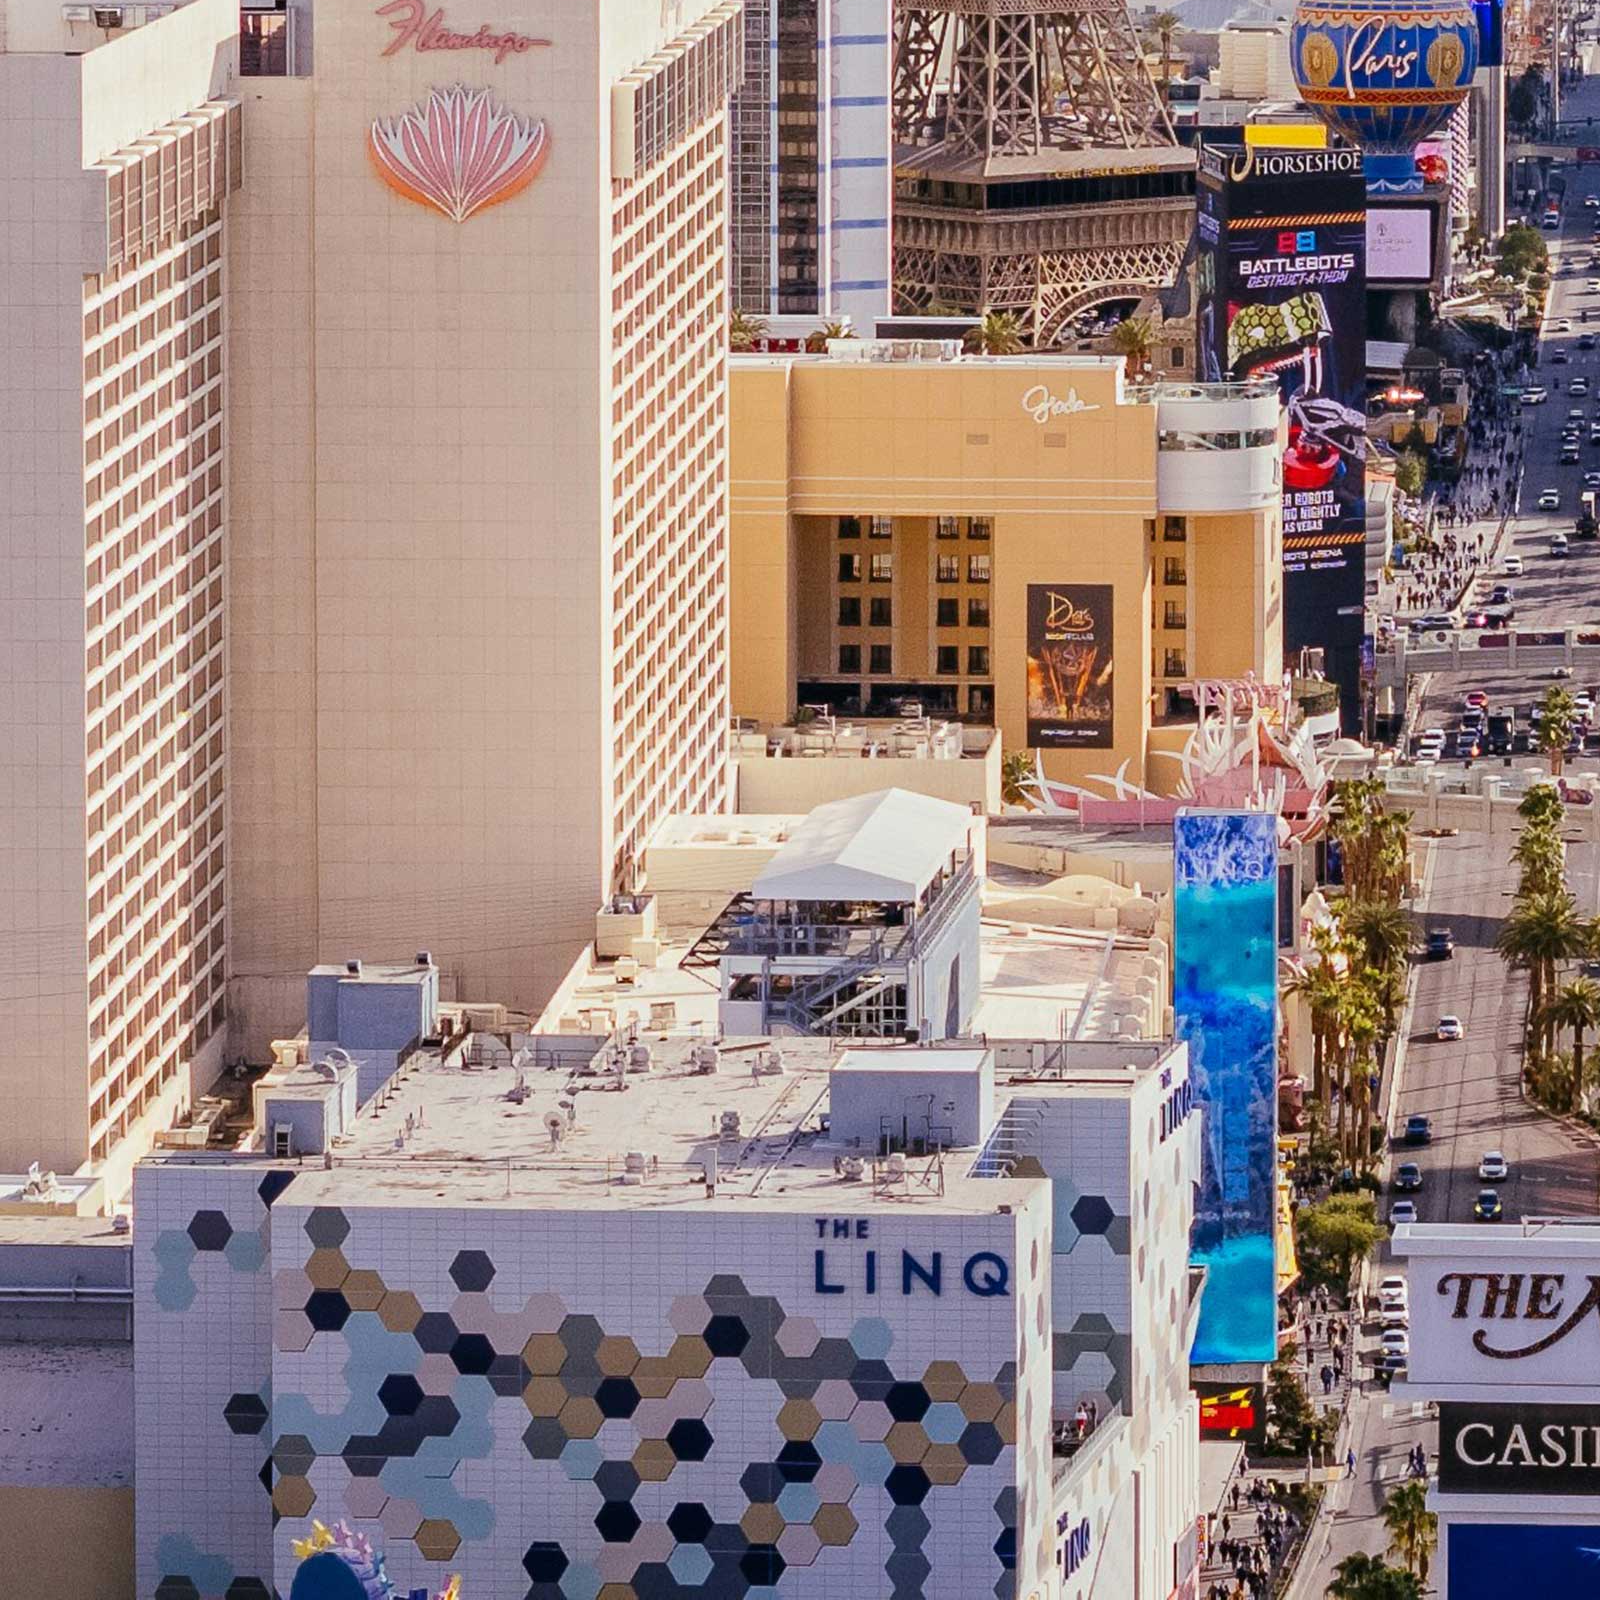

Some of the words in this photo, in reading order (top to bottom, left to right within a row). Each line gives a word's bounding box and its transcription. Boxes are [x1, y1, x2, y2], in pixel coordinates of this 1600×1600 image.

[1345, 14, 1418, 100] Paris
[1255, 151, 1362, 176] HORSESHOE
[1239, 253, 1355, 276] BATTLEBOTS
[815, 1218, 869, 1239] THE
[815, 1249, 1011, 1297] LINQ
[1436, 1271, 1566, 1321] THE
